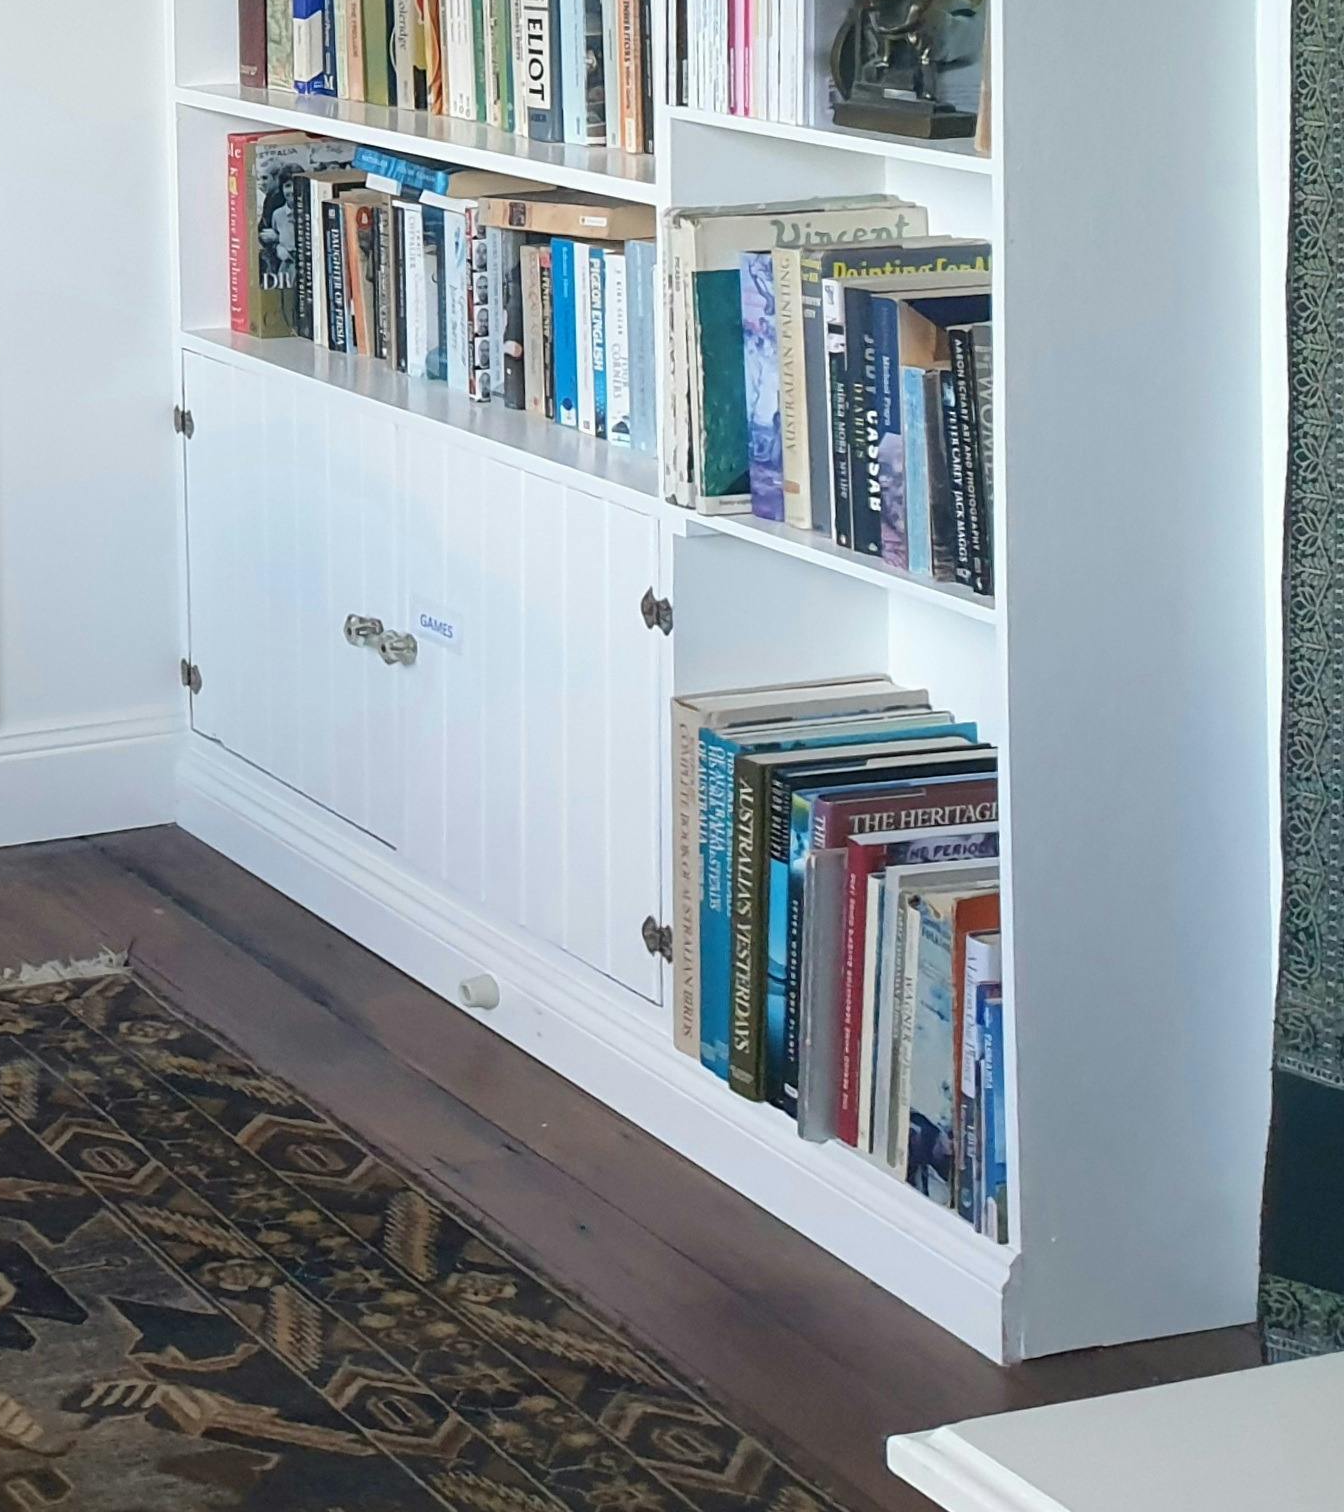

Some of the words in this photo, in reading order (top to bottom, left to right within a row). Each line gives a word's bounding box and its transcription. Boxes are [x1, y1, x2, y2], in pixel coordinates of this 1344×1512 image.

[527, 18, 546, 101] ELIOT
[770, 214, 909, 246] Vincent
[230, 237, 240, 302] Hepburn
[330, 228, 342, 289] DAUGHTER
[590, 258, 602, 308] PIGEON
[335, 292, 343, 306] OF
[780, 258, 792, 339] PAINTING
[336, 309, 345, 345] PERSIA
[592, 310, 603, 372] ENGLISH
[612, 343, 621, 399] CORNERS
[954, 339, 965, 377] AARON
[784, 347, 796, 451] AUSTRALIAN
[854, 383, 863, 458] DIARIES
[958, 380, 968, 420] SCHARF
[948, 411, 960, 445] PETER
[962, 424, 970, 443] ART
[865, 410, 882, 512] CASSAB
[951, 448, 962, 485] CAREY
[963, 446, 973, 468] AND
[953, 490, 964, 518] JACK
[965, 471, 980, 551] PHOTOGRAPHY
[956, 521, 967, 563] MAGGS
[420, 614, 454, 638] GAMES
[738, 779, 753, 916] AUSTRALIA'S
[849, 812, 896, 833] THE
[734, 922, 752, 1053] YESTERDAYS
[903, 977, 913, 1042] WAGNER
[682, 990, 693, 1039] BIRDS
[984, 1034, 993, 1088] TASMANIA
